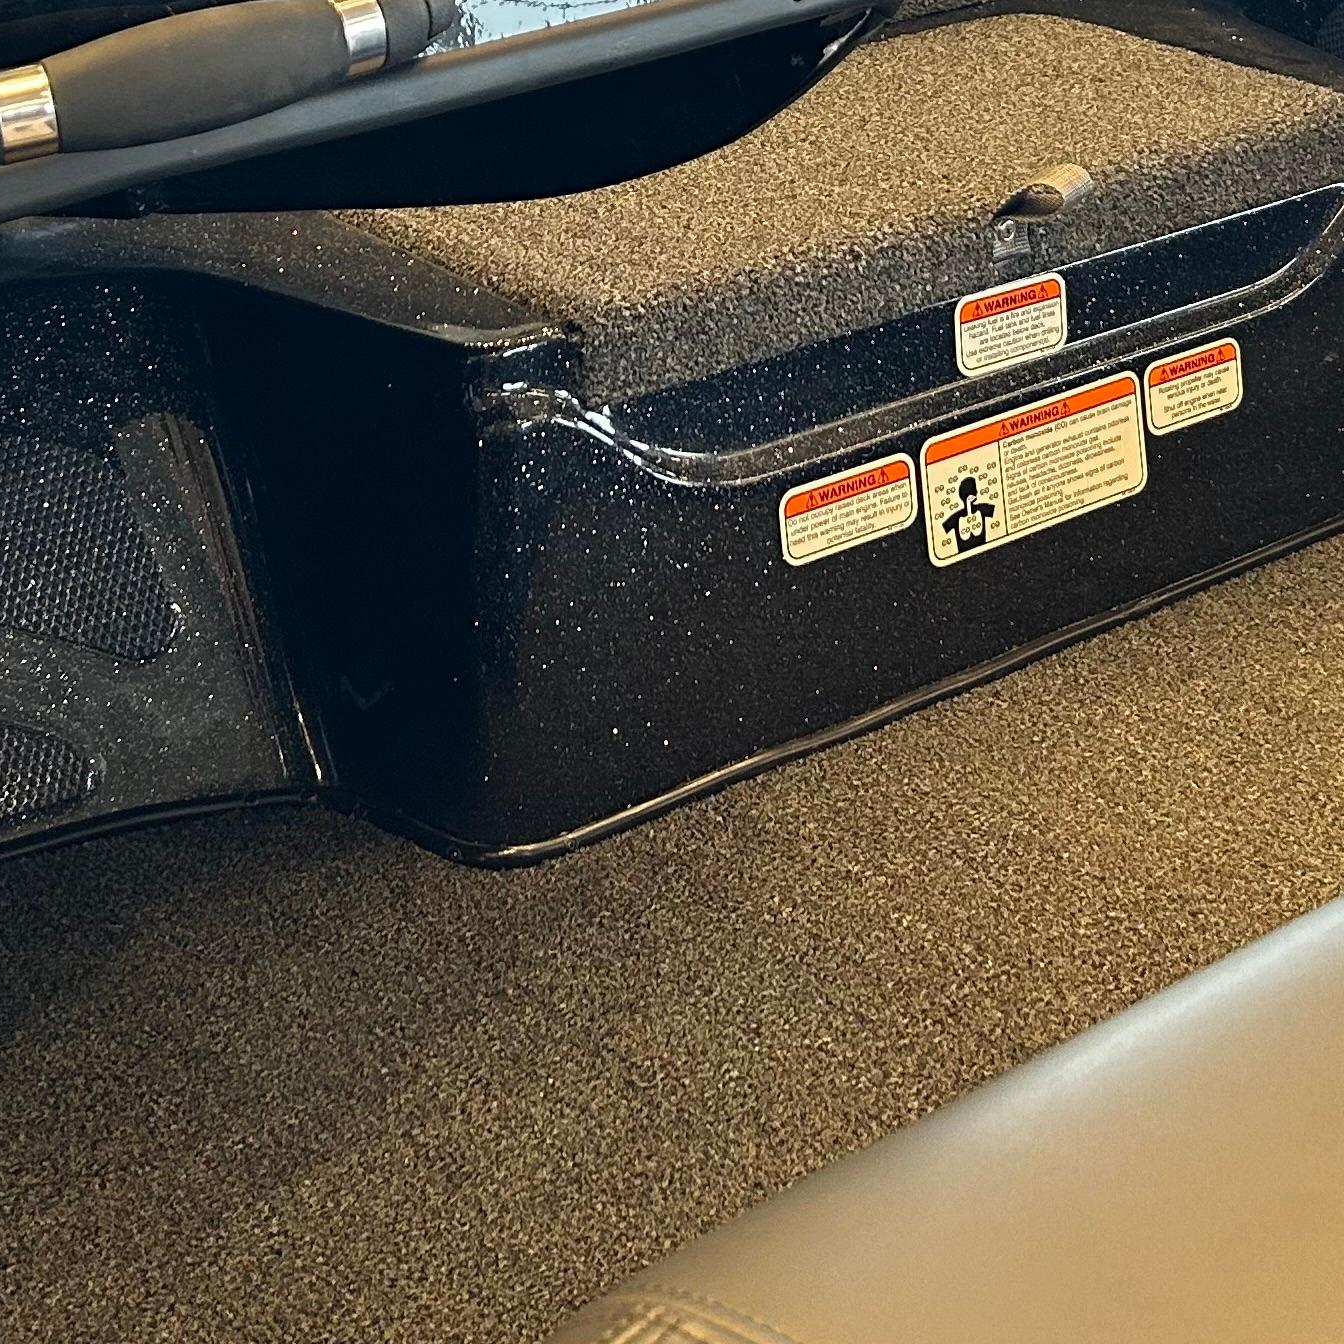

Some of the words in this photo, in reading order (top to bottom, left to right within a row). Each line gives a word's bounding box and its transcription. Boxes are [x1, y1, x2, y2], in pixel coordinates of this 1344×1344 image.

[984, 289, 1036, 313] WARNING
[1169, 354, 1215, 375] WARNING
[1010, 407, 1060, 430] WARNING
[819, 475, 876, 502] WARNING
